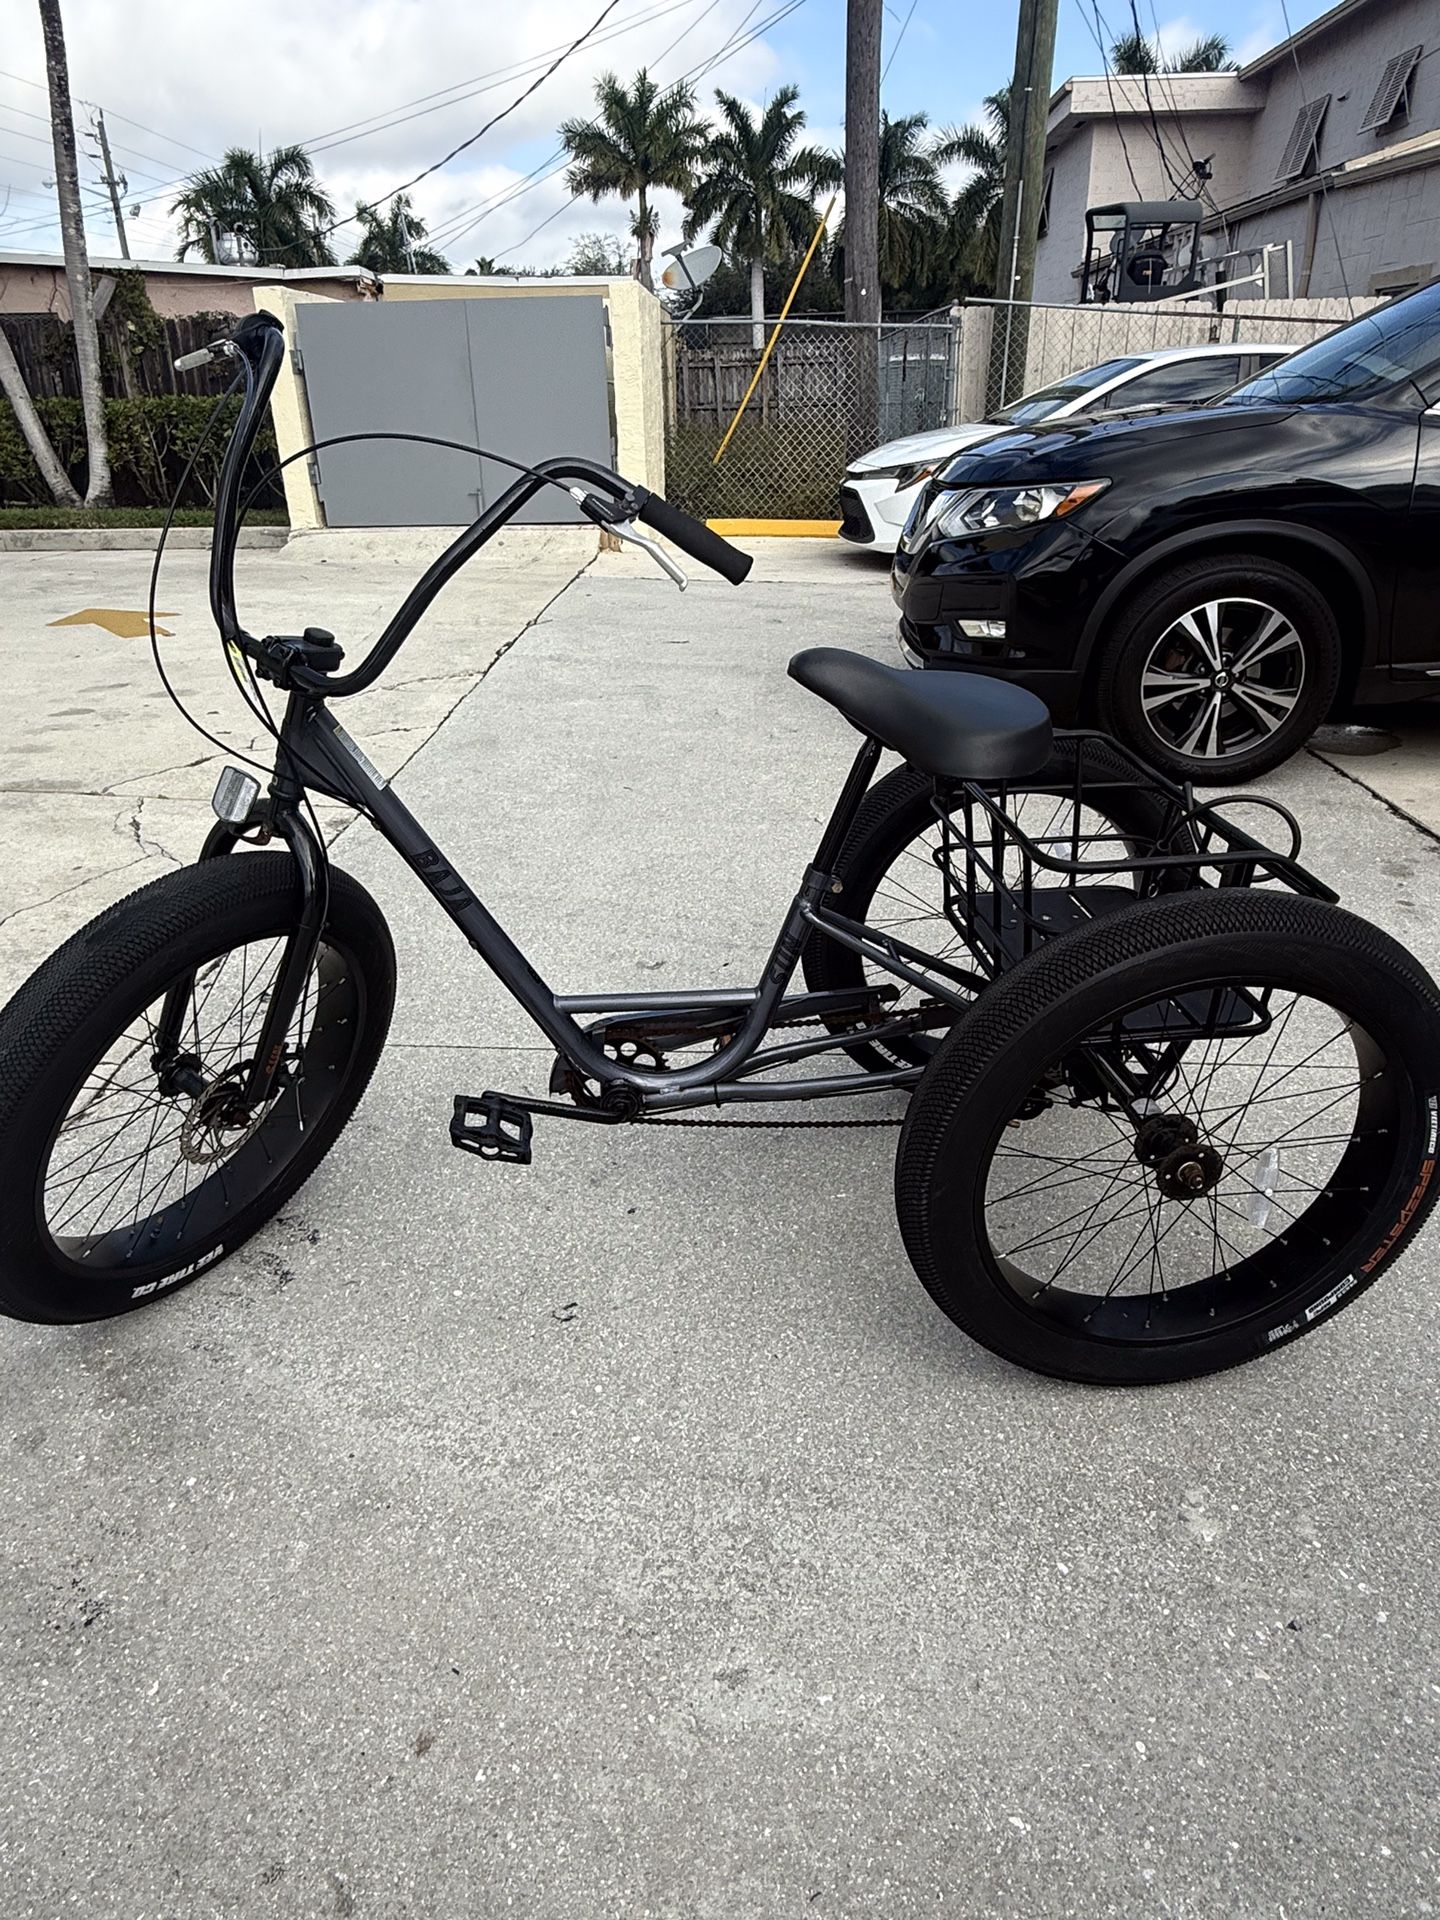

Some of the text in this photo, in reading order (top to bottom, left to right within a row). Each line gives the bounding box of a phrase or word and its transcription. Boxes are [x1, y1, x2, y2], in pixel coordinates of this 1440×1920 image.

[413, 850, 474, 912] BAJA
[868, 1039, 898, 1064] TIRE
[1360, 1159, 1436, 1273] SPEEDSTER
[157, 1263, 195, 1290] TIRE
[1308, 1278, 1351, 1313] COMPOUND
